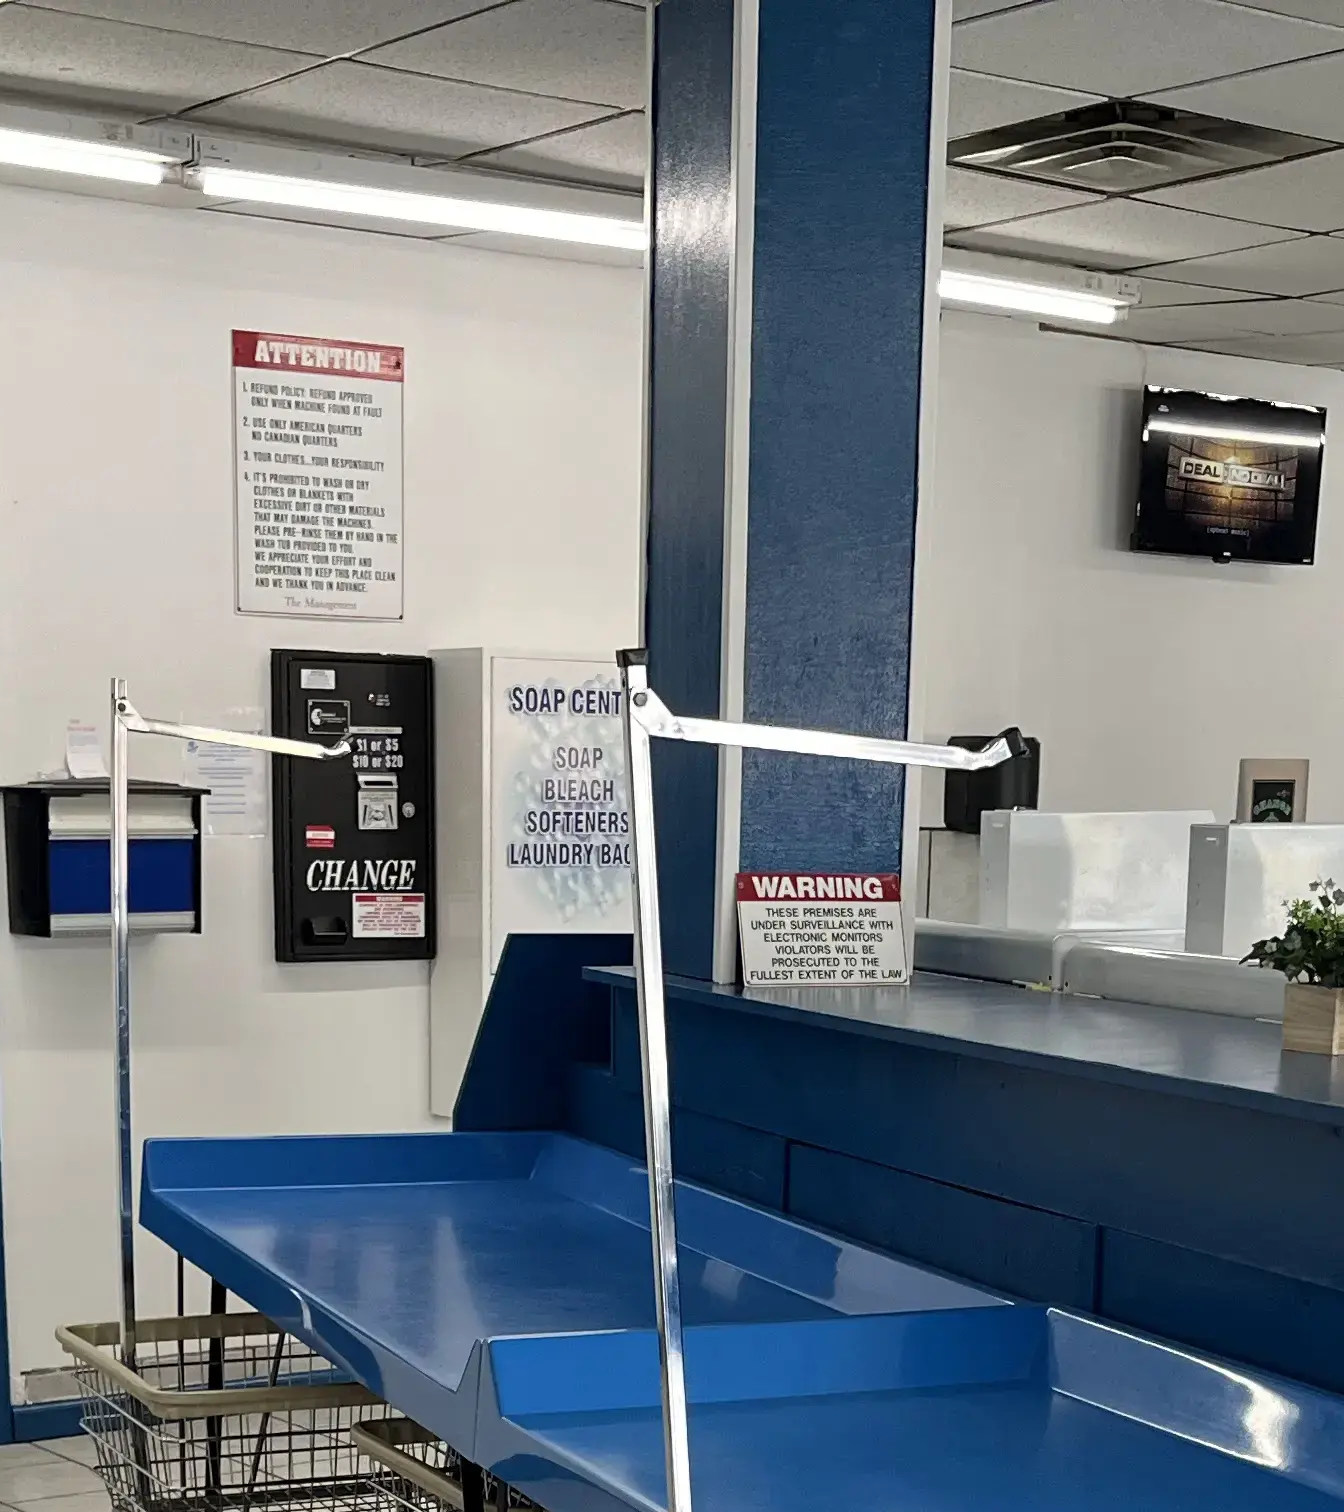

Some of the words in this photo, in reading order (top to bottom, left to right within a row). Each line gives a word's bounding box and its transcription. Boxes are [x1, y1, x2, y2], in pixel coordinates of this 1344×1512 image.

[254, 339, 381, 374] ATTENTION
[1183, 461, 1221, 478] DEAL
[272, 577, 283, 587] WE
[286, 578, 307, 589] THANK
[311, 580, 323, 590] YOU
[512, 686, 566, 713] SOAP
[571, 689, 622, 715] CENT
[370, 740, 383, 752] or
[385, 738, 399, 752] $5
[352, 754, 369, 768] $10
[371, 756, 383, 768] or
[385, 754, 404, 768] $20
[556, 746, 603, 769] SOAP
[544, 779, 614, 801] BLEACH
[527, 811, 629, 833] SOFTENERS
[510, 843, 593, 865] LAUNDRY
[306, 858, 417, 892] CHANGE
[751, 876, 883, 898] WARNING
[765, 907, 798, 917] THESE
[803, 908, 853, 917] PREMISES
[857, 908, 876, 917] ARE
[750, 920, 785, 929] UNDER
[790, 920, 864, 929] SURVEILLANCE
[869, 920, 893, 930] WITH
[763, 932, 827, 942] ELECTRONIC
[831, 933, 882, 942] MONITORS
[774, 945, 830, 954] VIOLATORS
[835, 945, 857, 954] WILL
[862, 945, 875, 954] BE
[771, 957, 839, 966] PROSECUTED
[844, 957, 856, 966] TO
[860, 957, 879, 966] THE
[750, 970, 794, 980] FULLEST
[798, 970, 837, 979] EXTENT
[841, 970, 854, 979] OF
[858, 970, 877, 979] THE
[881, 970, 902, 979] LAW
